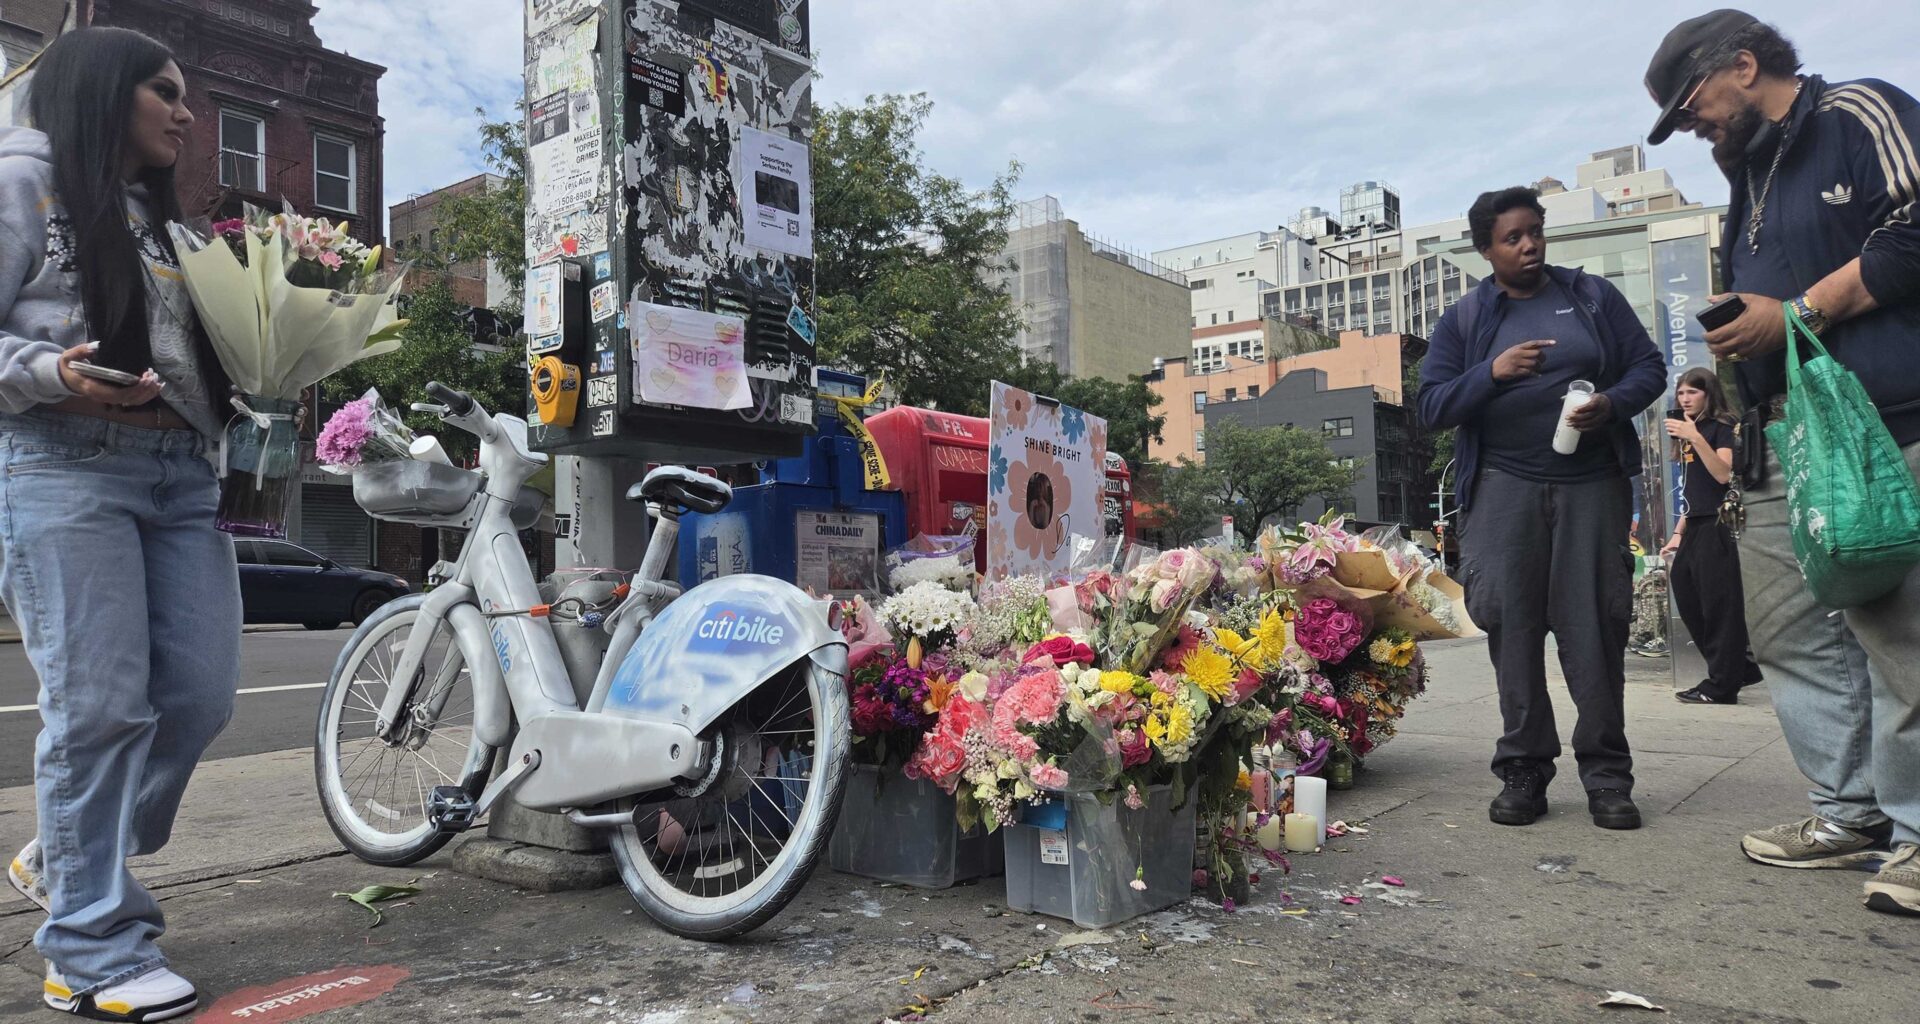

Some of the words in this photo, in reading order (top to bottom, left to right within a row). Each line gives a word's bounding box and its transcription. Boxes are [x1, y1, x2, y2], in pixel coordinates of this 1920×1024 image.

[632, 73, 652, 84] DEFEND
[650, 71, 664, 81] YOUR
[576, 139, 599, 153] TOPPED
[576, 149, 599, 164] GRIMES
[1668, 273, 1688, 283] 1
[1669, 292, 1689, 366] Avenue
[1024, 436, 1050, 454] SHINE
[1052, 446, 1081, 462] BRIGHT
[573, 502, 581, 538] DARIA
[815, 525, 842, 537] CHINA
[842, 527, 864, 538] DAILY
[699, 611, 733, 640] citi
[733, 613, 784, 645] bike
[493, 627, 512, 675] bike
